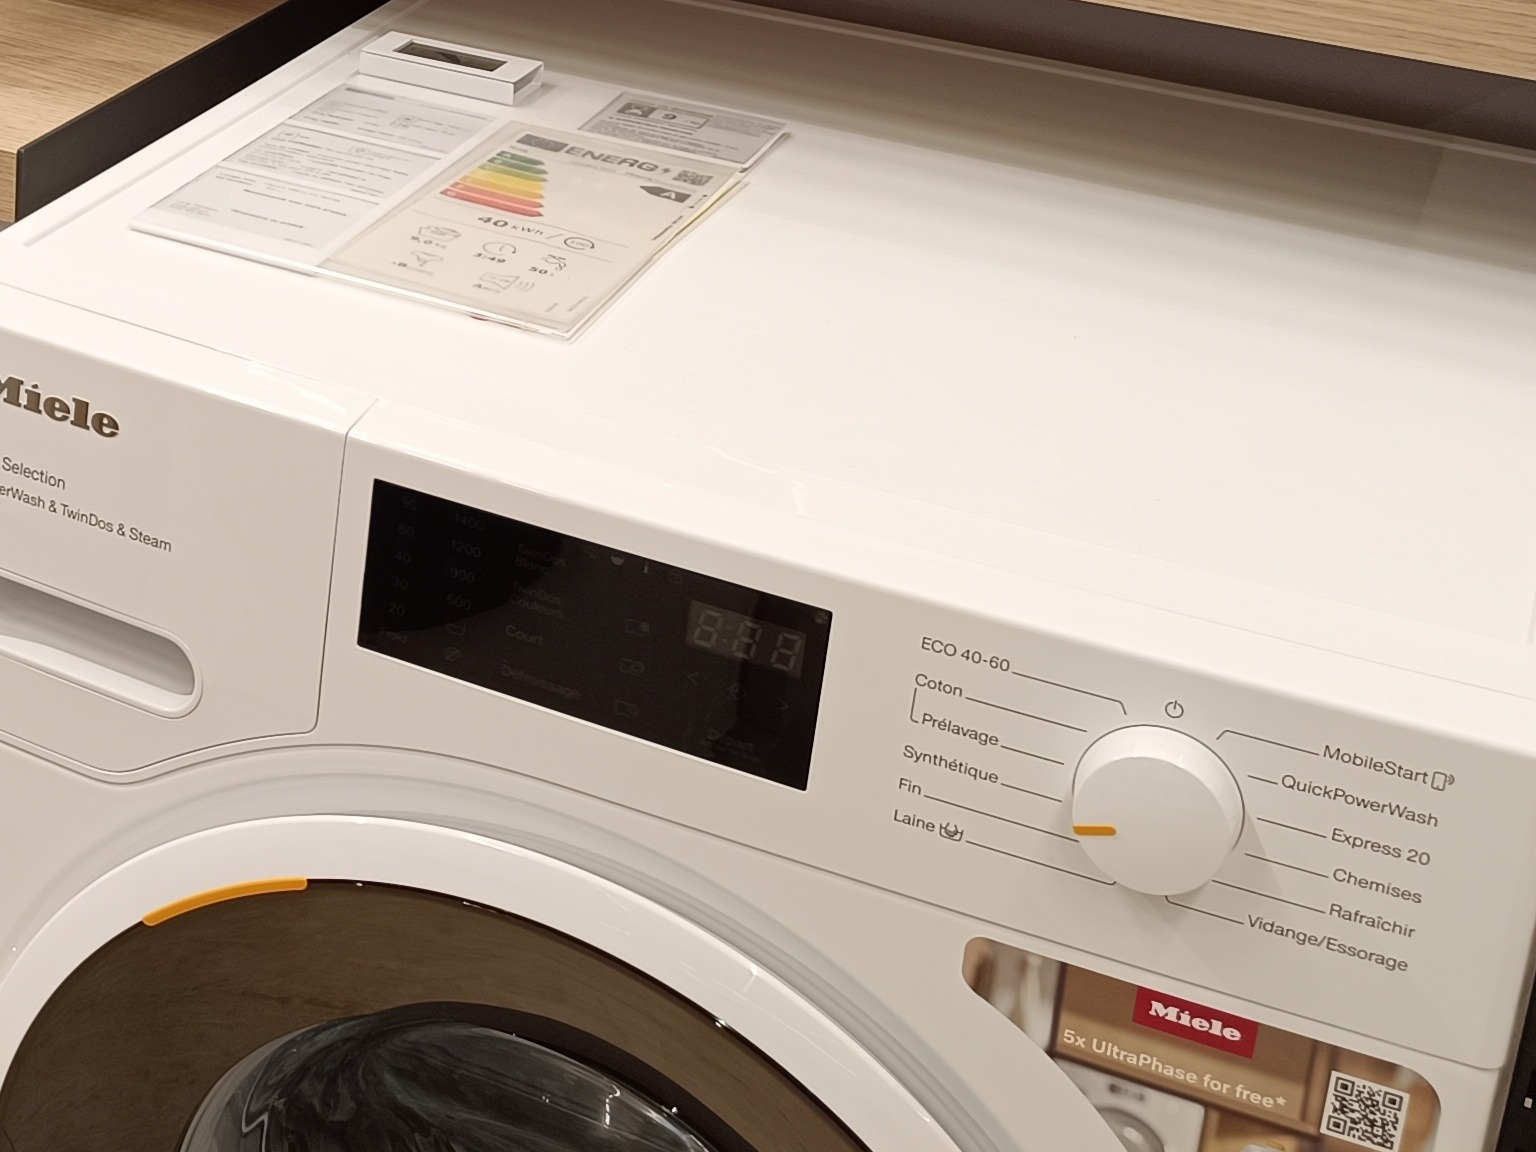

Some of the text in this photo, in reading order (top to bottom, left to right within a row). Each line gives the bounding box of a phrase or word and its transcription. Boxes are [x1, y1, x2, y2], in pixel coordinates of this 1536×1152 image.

[565, 147, 659, 173] ENERG
[478, 216, 509, 228] 40
[2, 457, 65, 490] Selection
[49, 500, 57, 513] &
[61, 503, 113, 533] TwinDos
[117, 524, 126, 537] &
[129, 527, 172, 552] Steam
[921, 637, 1010, 673] ECO 40-60
[915, 673, 963, 698] Coton
[922, 712, 999, 747] Prélavage
[902, 745, 999, 785] Synthétique
[1322, 745, 1429, 785] MobileStart
[898, 777, 922, 796] Fin
[1281, 774, 1439, 828] QuickPowerWash
[894, 809, 936, 833] Laine
[1331, 829, 1431, 867] Express 20
[1332, 868, 1422, 904] Chemises
[1328, 904, 1416, 939] Rafraîchir
[1247, 915, 1409, 973] Vidange/Essorage
[1148, 1000, 1241, 1042] Miele
[1063, 1029, 1086, 1048] 5x
[1091, 1039, 1198, 1085] UltraPhase
[1202, 1073, 1232, 1095] for
